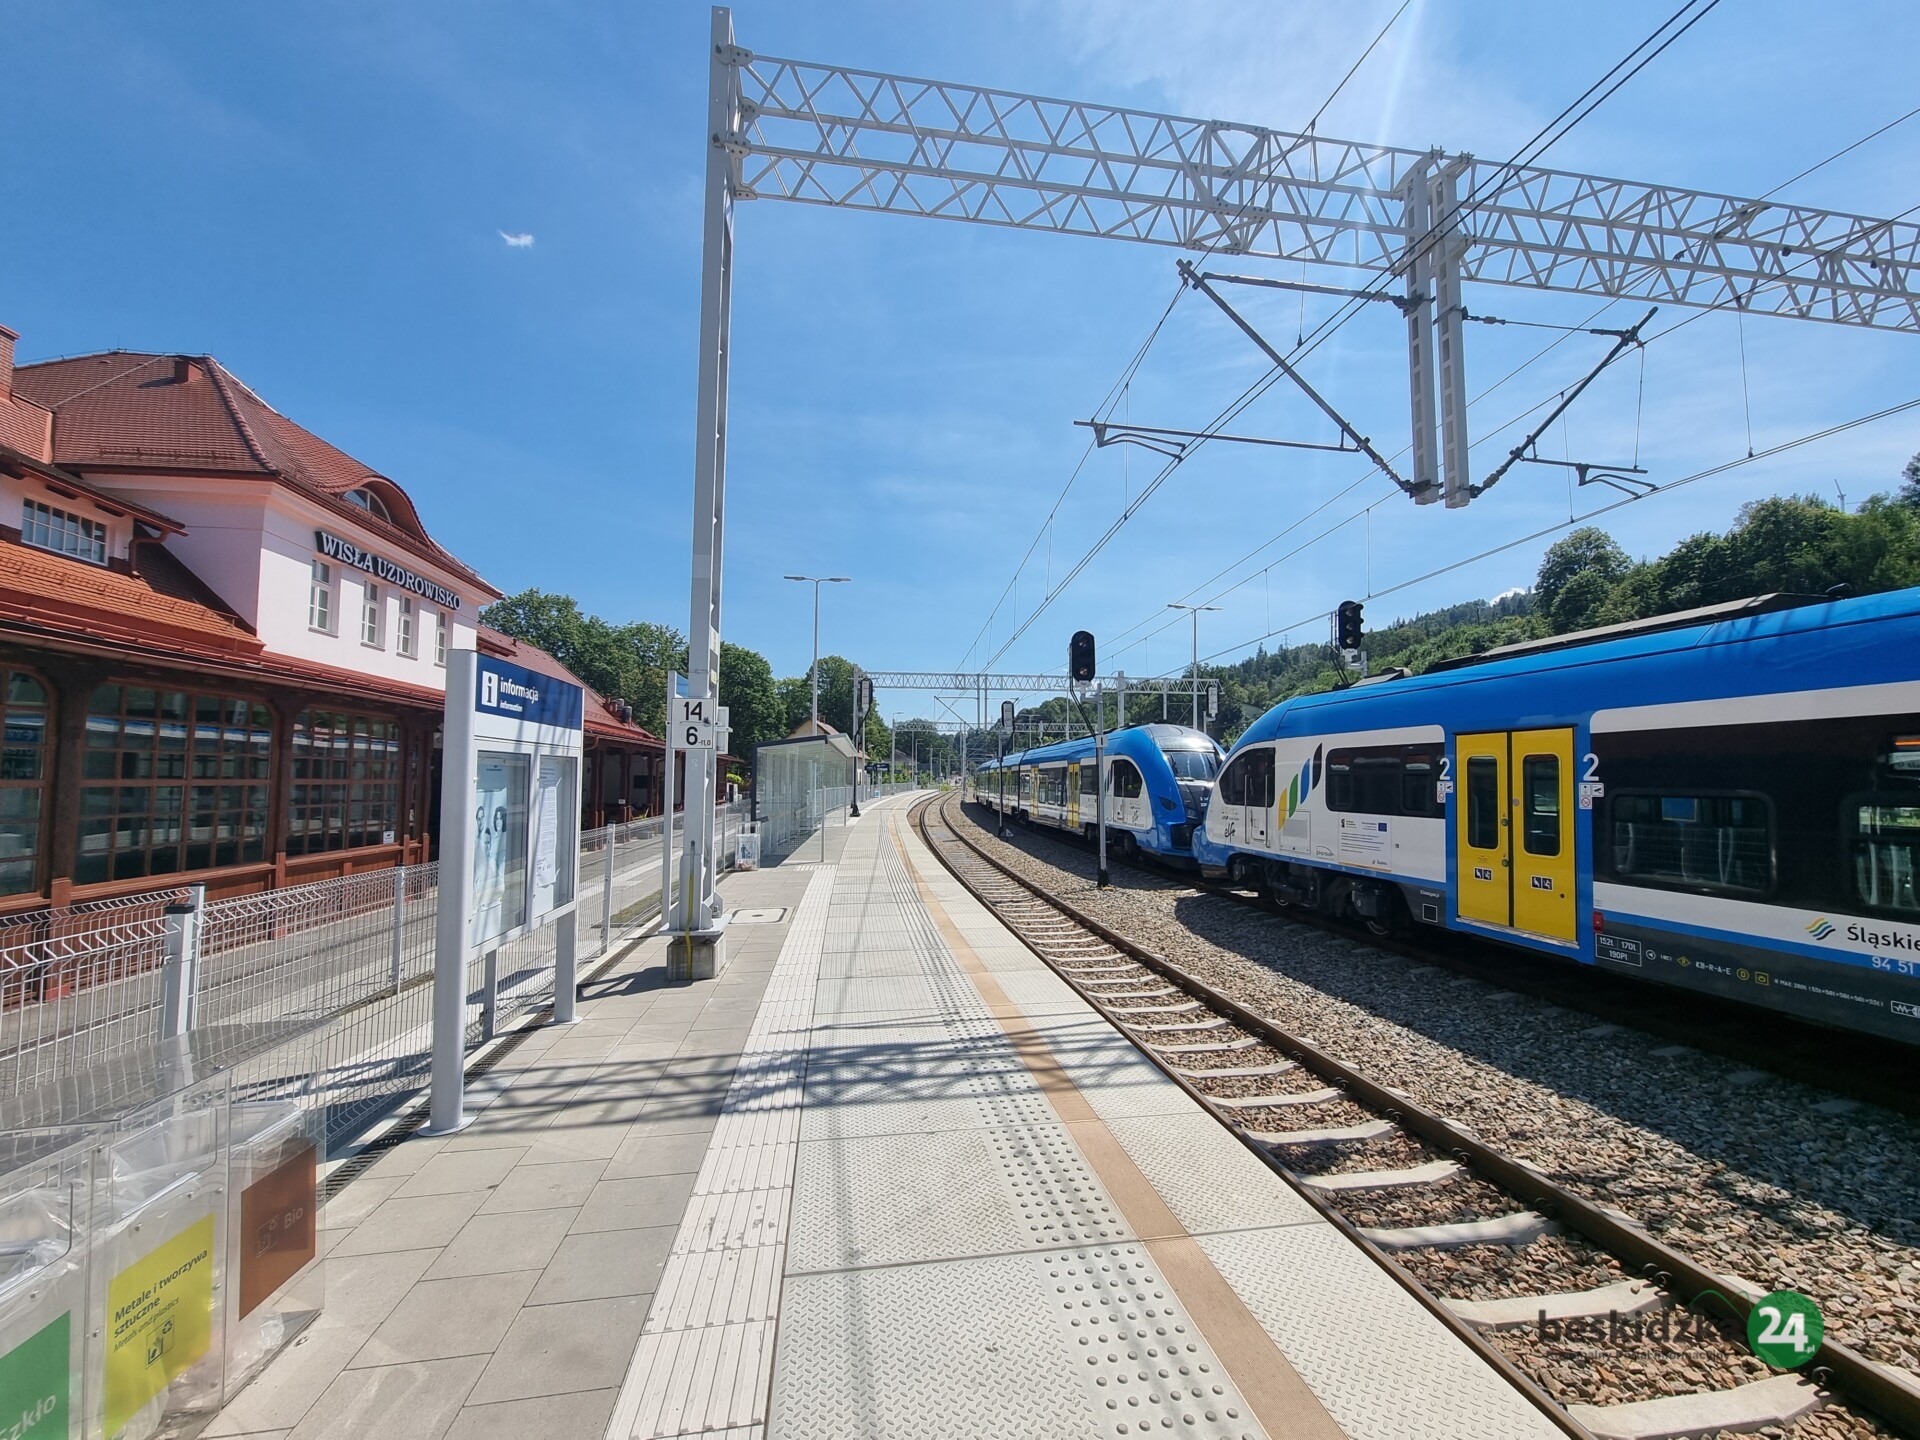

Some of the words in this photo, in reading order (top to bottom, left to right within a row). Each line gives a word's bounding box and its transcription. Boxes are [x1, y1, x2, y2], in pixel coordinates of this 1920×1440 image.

[321, 532, 374, 573] WISŁA
[376, 557, 462, 611] UZDROWISKO
[500, 676, 539, 704] informacja
[683, 701, 703, 721] 14
[686, 726, 699, 746] 6
[1438, 757, 1451, 781] 2
[1582, 752, 1600, 781] 2
[1846, 923, 1920, 951] Śląskie
[1871, 956, 1891, 970] 94
[1897, 960, 1914, 975] 51
[284, 1207, 304, 1229] Bio
[114, 1290, 151, 1324] Metale
[153, 1283, 157, 1293] i
[159, 1249, 208, 1289] tworzywa
[114, 1297, 160, 1339] sztuczne
[0, 1395, 56, 1440] zkło
